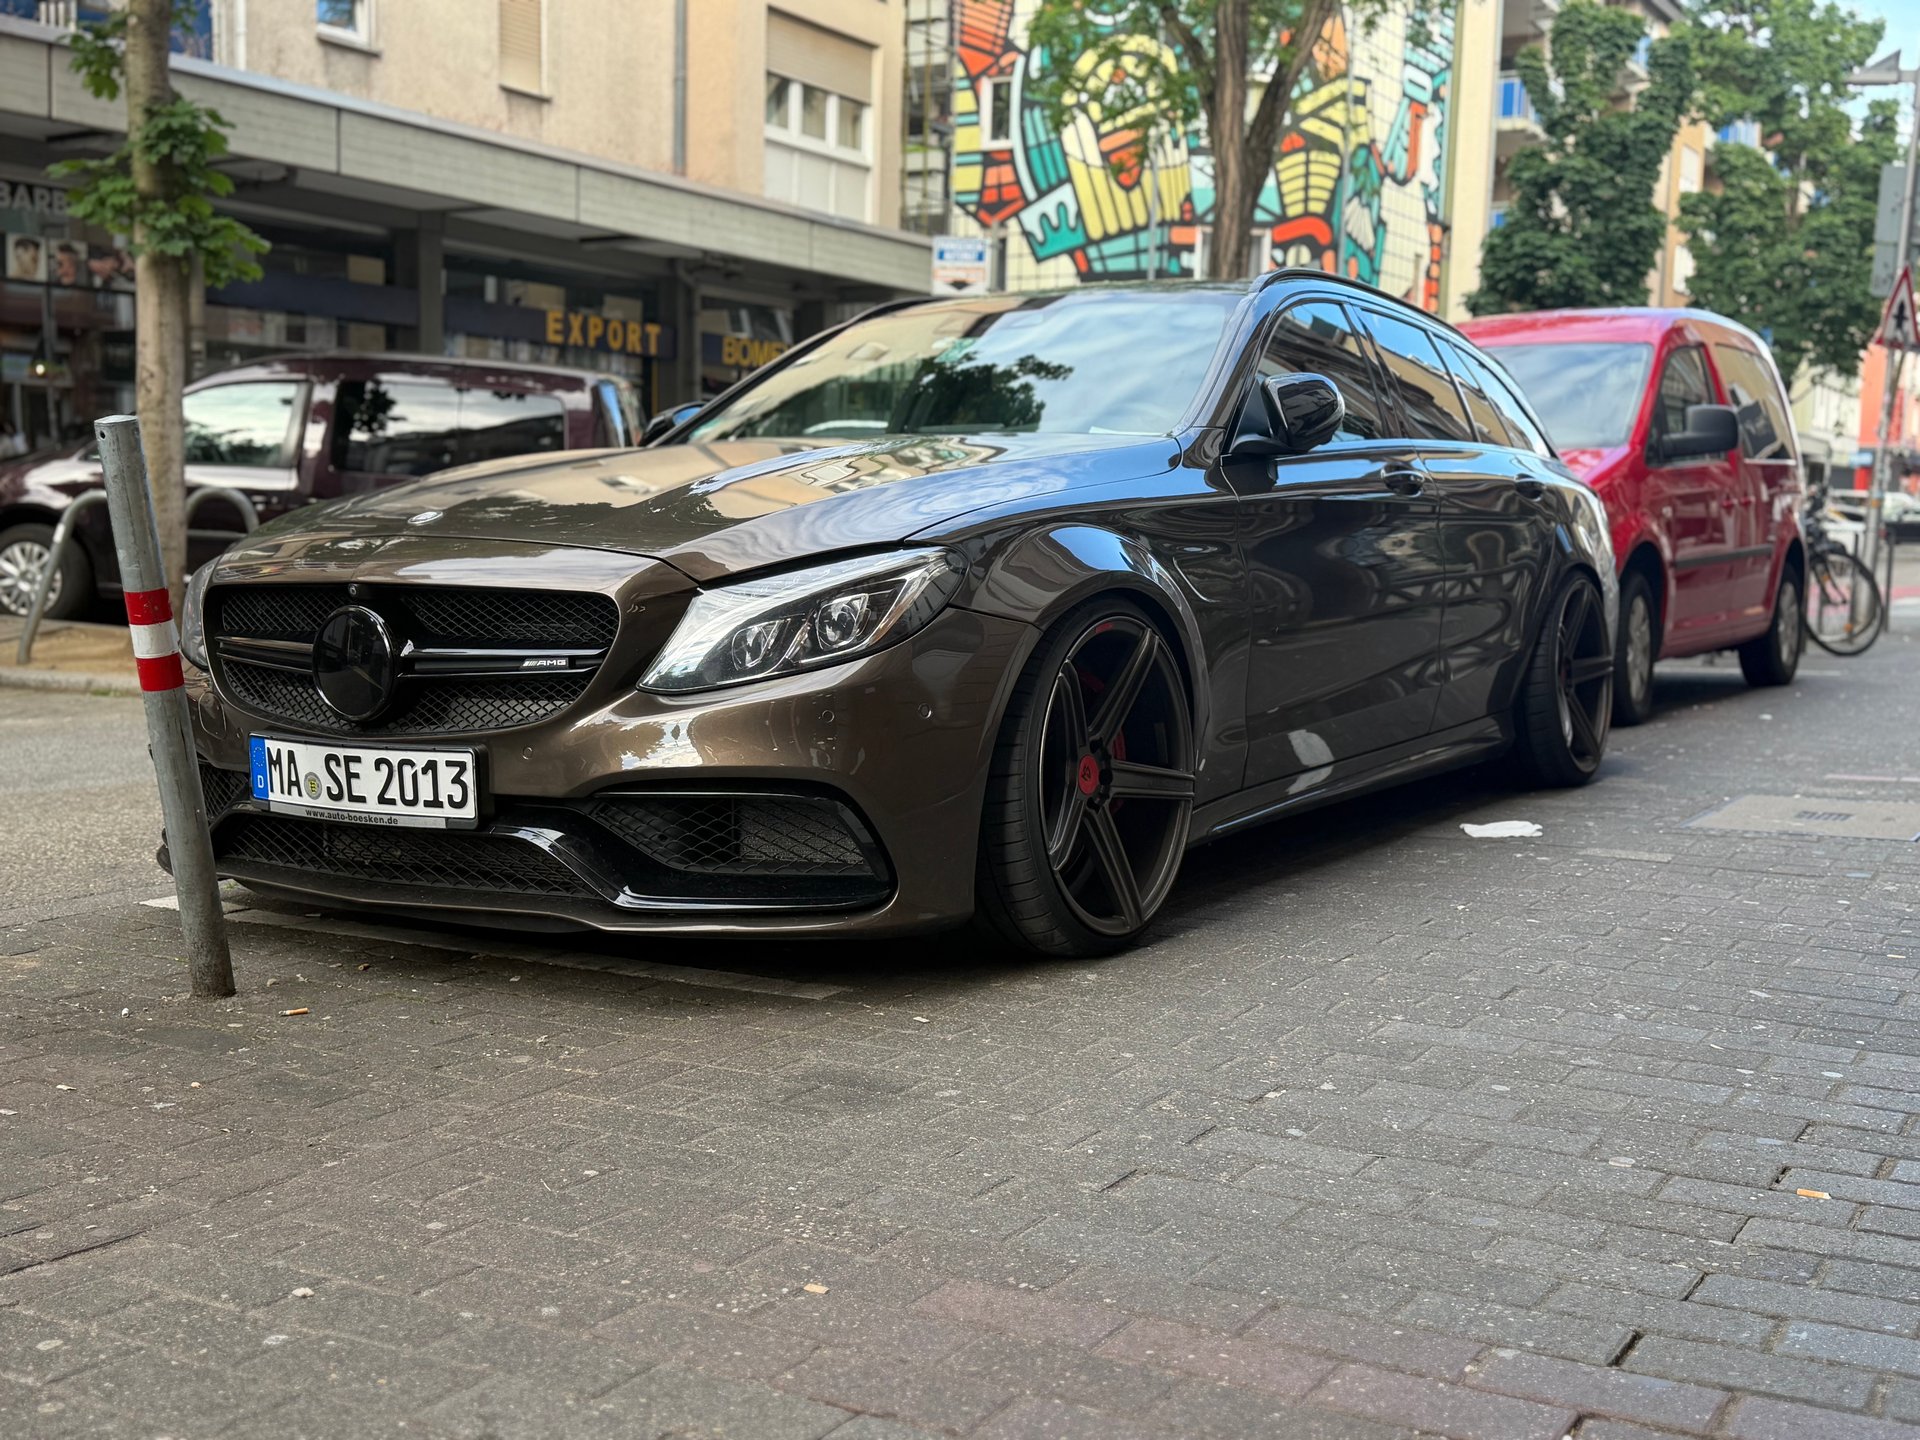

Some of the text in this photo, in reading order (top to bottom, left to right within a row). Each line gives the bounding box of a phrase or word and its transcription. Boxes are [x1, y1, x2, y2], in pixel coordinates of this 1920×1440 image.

[546, 309, 662, 356] EXPORT
[257, 774, 265, 789] D
[266, 746, 469, 810] MA SE 2013
[305, 808, 399, 825] www.auto-boesken.de
